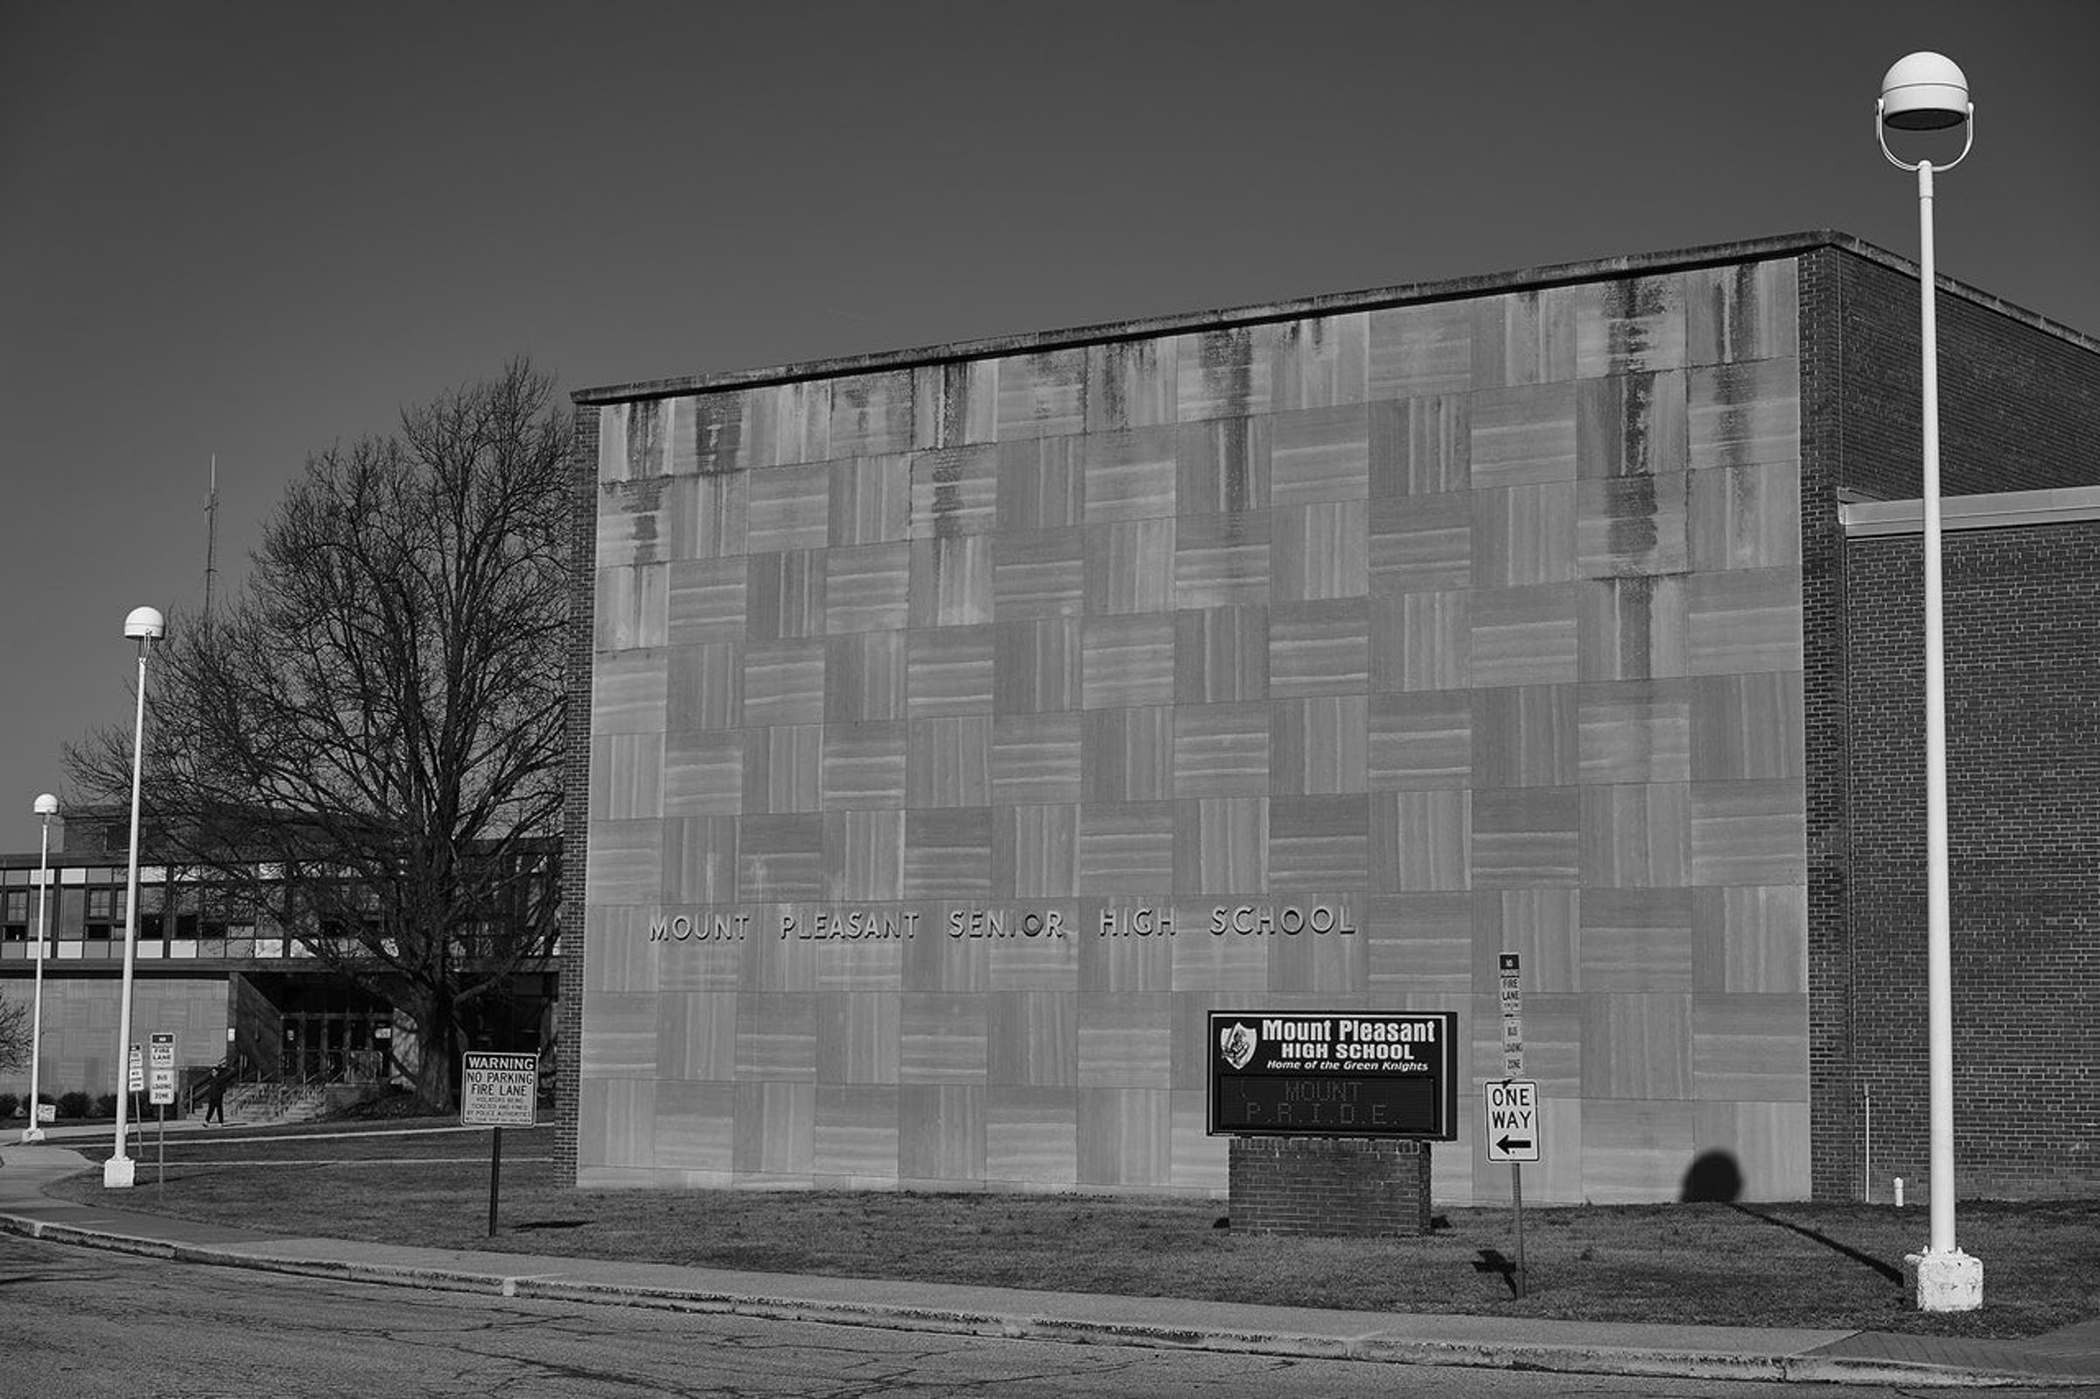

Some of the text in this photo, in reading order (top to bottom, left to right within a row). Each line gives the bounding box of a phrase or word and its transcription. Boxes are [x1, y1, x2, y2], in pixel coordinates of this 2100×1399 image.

[649, 905, 1356, 941] MOUNT PLEASANT SENIOR HIGH SCHOOL
[1502, 991, 1520, 1001] LANE
[1262, 1019, 1435, 1042] Mount Pleasant
[1281, 1043, 1415, 1060] HIGH SCHOOL
[468, 1057, 534, 1070] WARNING
[1266, 1060, 1429, 1072] Home of the Green Knights
[467, 1071, 534, 1085] NO PARKING
[471, 1084, 527, 1096] FIRE LANE
[1285, 1080, 1363, 1102] MOUNT
[1492, 1088, 1530, 1107] ONE
[1492, 1111, 1532, 1129] WAY
